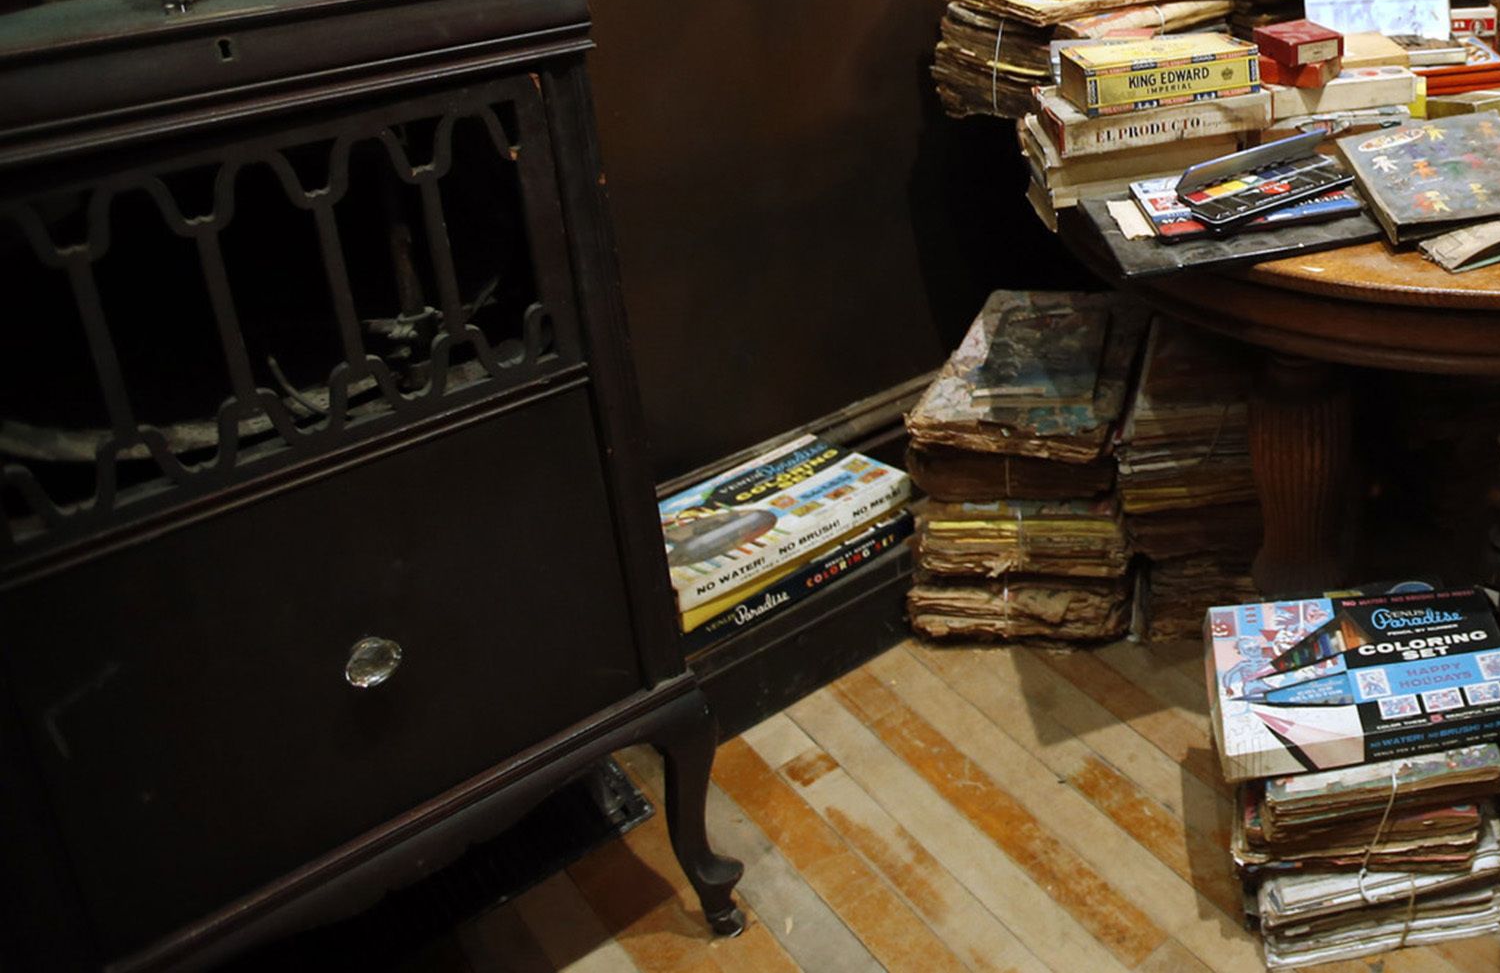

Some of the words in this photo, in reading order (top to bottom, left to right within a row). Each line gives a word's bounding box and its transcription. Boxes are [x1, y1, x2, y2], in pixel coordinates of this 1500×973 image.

[1128, 74, 1157, 89] KING
[1160, 67, 1210, 84] EDWARD
[1146, 83, 1192, 94] IMPERIAL
[1096, 130, 1115, 143] EL
[1118, 117, 1200, 140] PRODUCTO
[697, 582, 715, 595] NO
[719, 557, 766, 583] WATER!
[779, 542, 795, 555] NO
[799, 519, 840, 544] BRUSH!
[852, 506, 868, 517] NO
[805, 549, 871, 588] COLORING
[734, 590, 790, 626] Paradise
[1371, 608, 1463, 630] Paradise
[1384, 609, 1426, 619] VENUS
[1358, 630, 1488, 656] COLORING
[1401, 646, 1449, 661] SET
[1398, 671, 1473, 689] HOLIDAYS
[1406, 662, 1461, 677] HAPPY
[1382, 733, 1425, 746] WATER!
